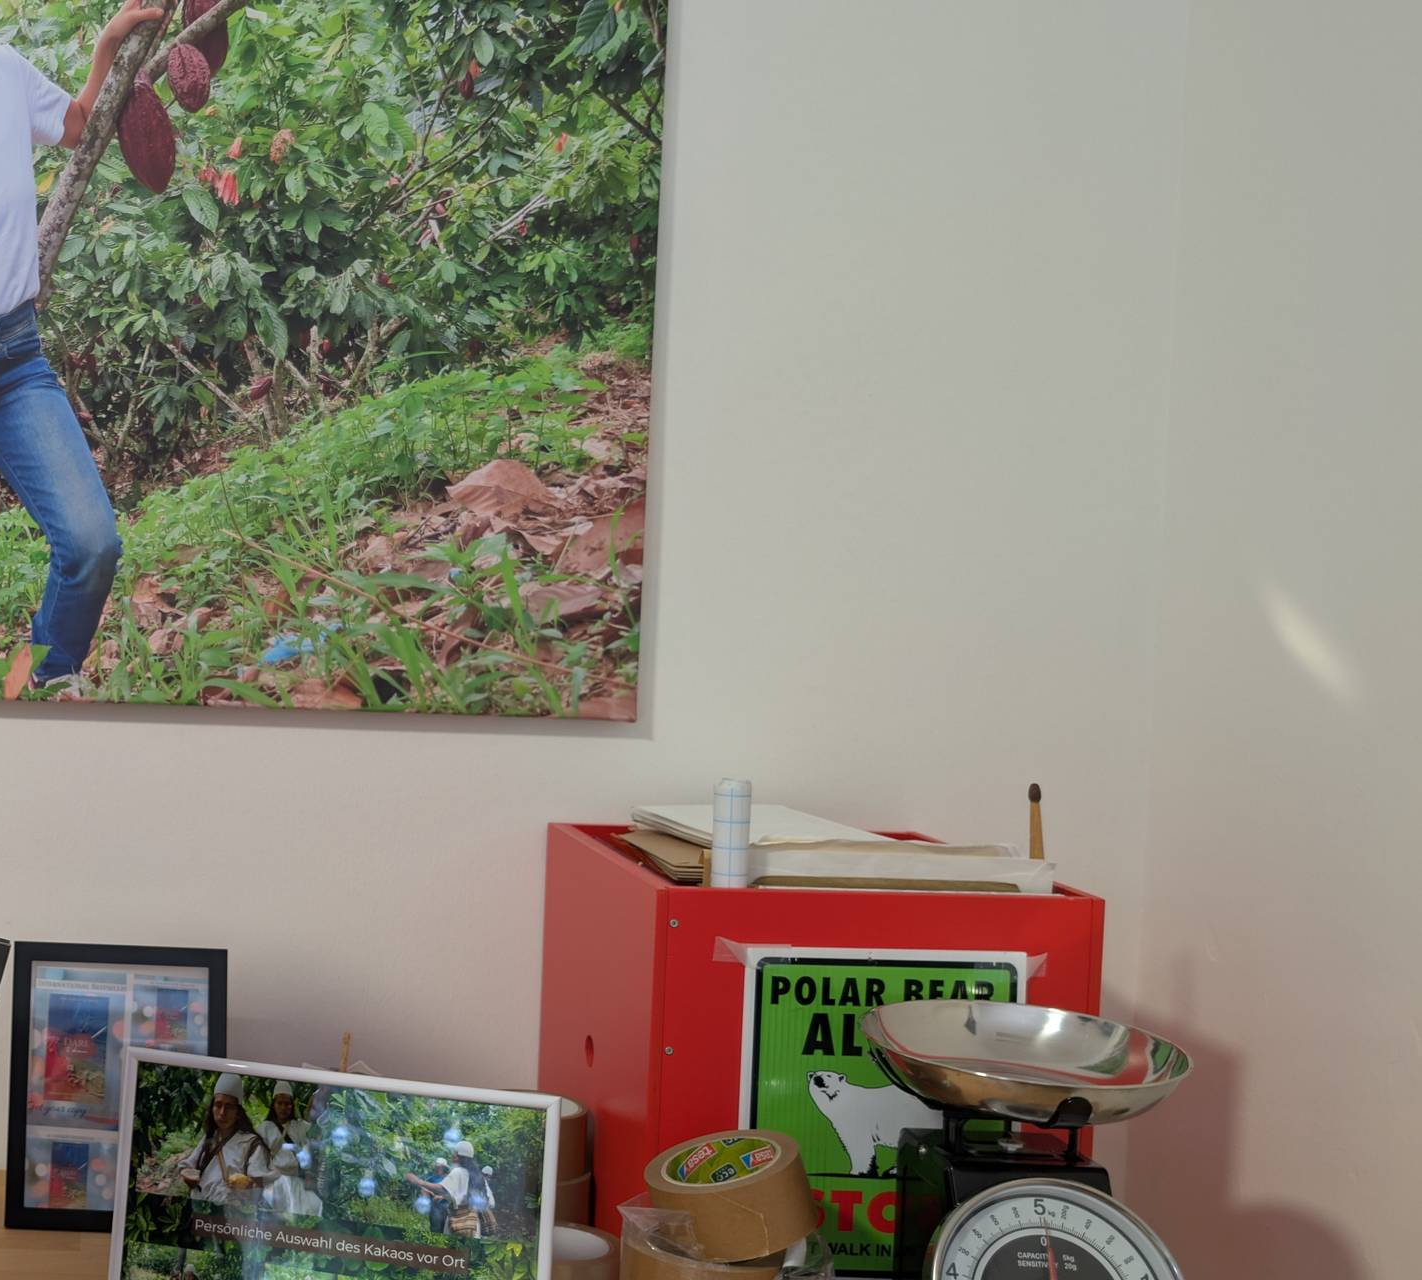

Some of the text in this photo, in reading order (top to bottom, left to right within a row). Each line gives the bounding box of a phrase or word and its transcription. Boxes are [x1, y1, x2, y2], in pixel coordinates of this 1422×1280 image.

[770, 976, 995, 1006] POLAR BEAR
[687, 1146, 713, 1169] tesa
[1033, 1199, 1046, 1216] 5
[194, 1219, 466, 1269] Persönliche Auswahl des Kakaos vor Ort
[876, 1244, 891, 1257] IN
[1040, 1236, 1047, 1247] 0
[946, 1262, 959, 1280] 4
